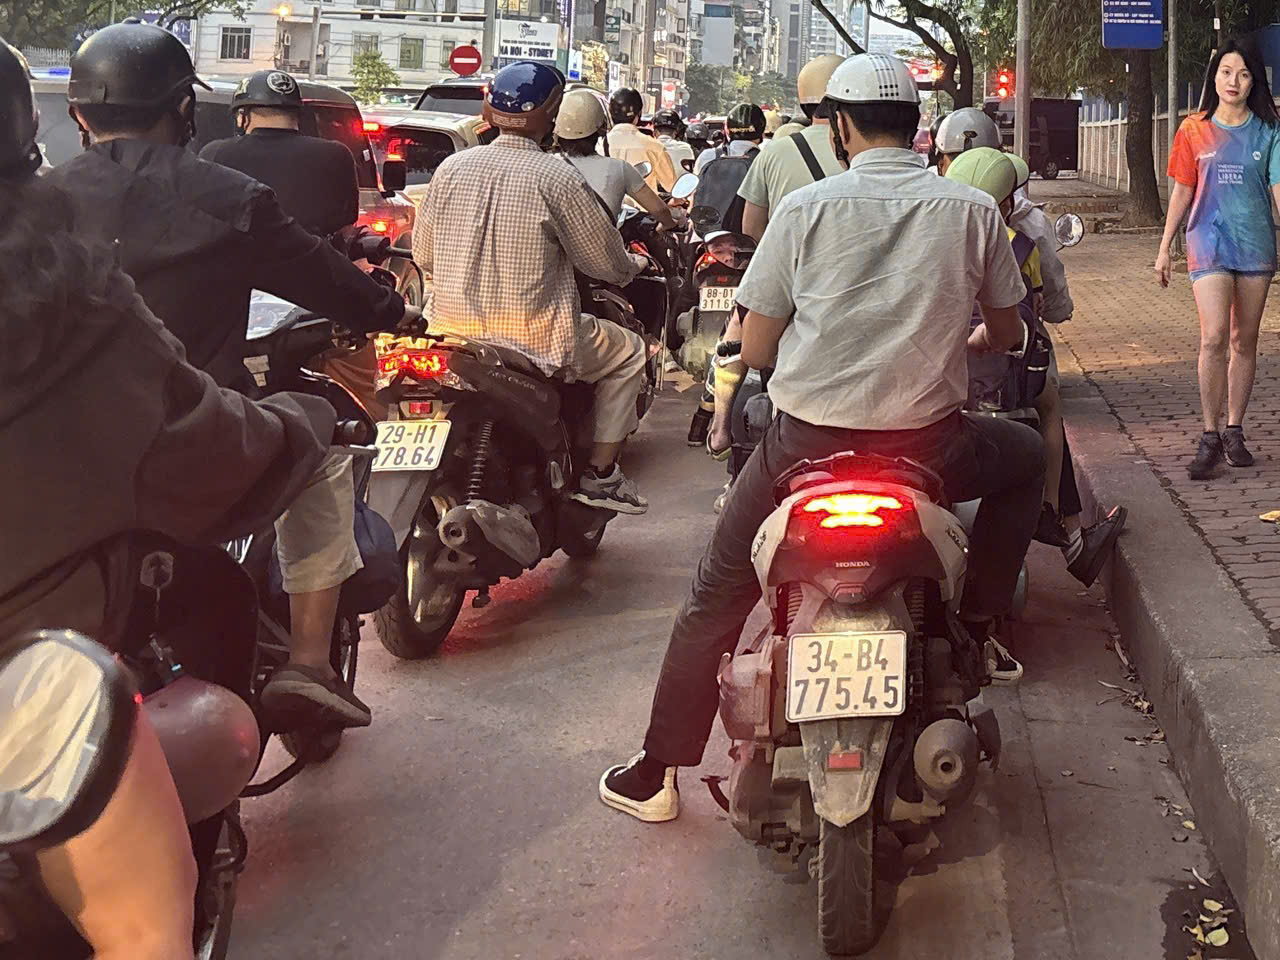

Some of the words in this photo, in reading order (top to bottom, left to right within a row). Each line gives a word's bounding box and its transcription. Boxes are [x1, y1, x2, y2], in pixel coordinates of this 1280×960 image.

[381, 424, 437, 444] 29-H1
[807, 638, 889, 673] 34-B4
[794, 674, 899, 716] 775.45
